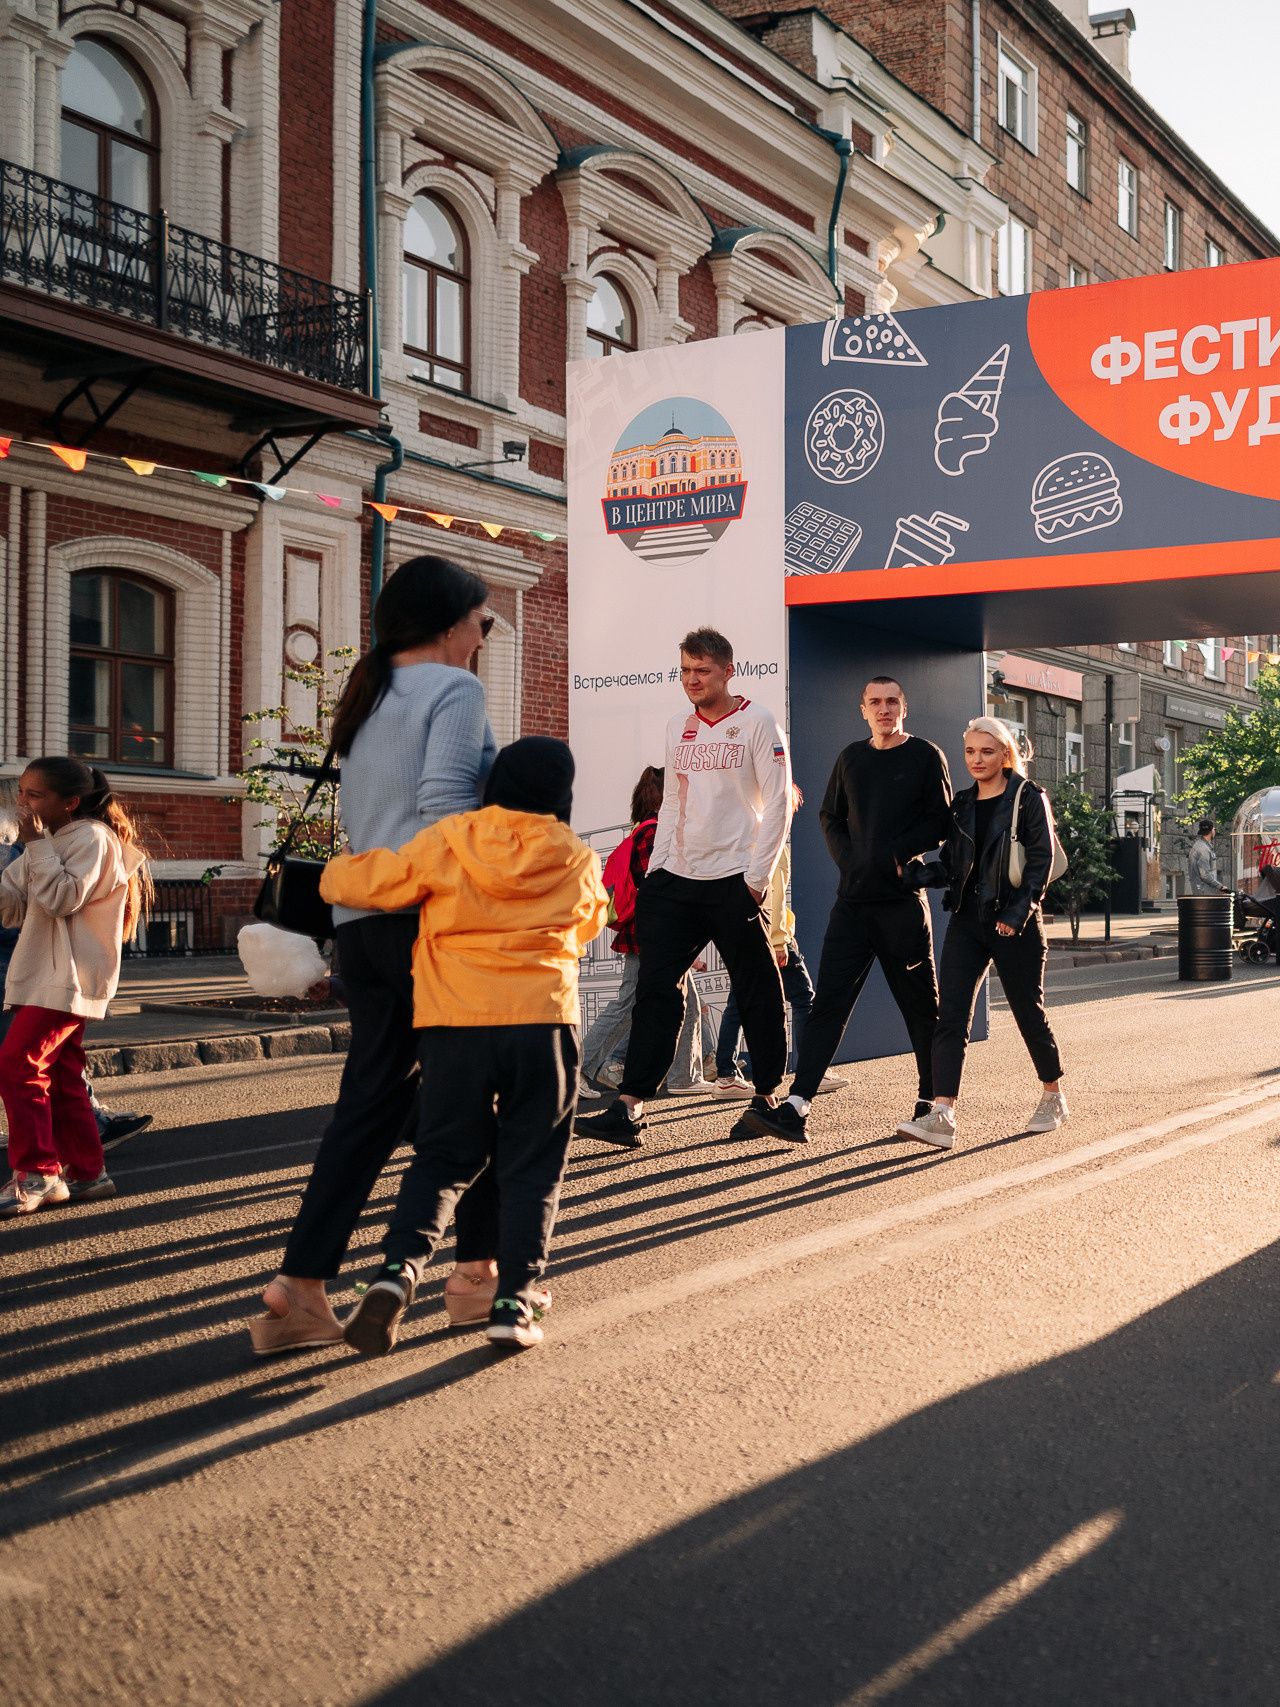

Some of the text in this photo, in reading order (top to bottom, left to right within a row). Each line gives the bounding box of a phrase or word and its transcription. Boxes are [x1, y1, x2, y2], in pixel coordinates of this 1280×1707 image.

[611, 493, 737, 526] В ЦЕНТРЕ МИРА
[574, 672, 663, 693] Встречаемся
[673, 743, 746, 772] RUSSIA
